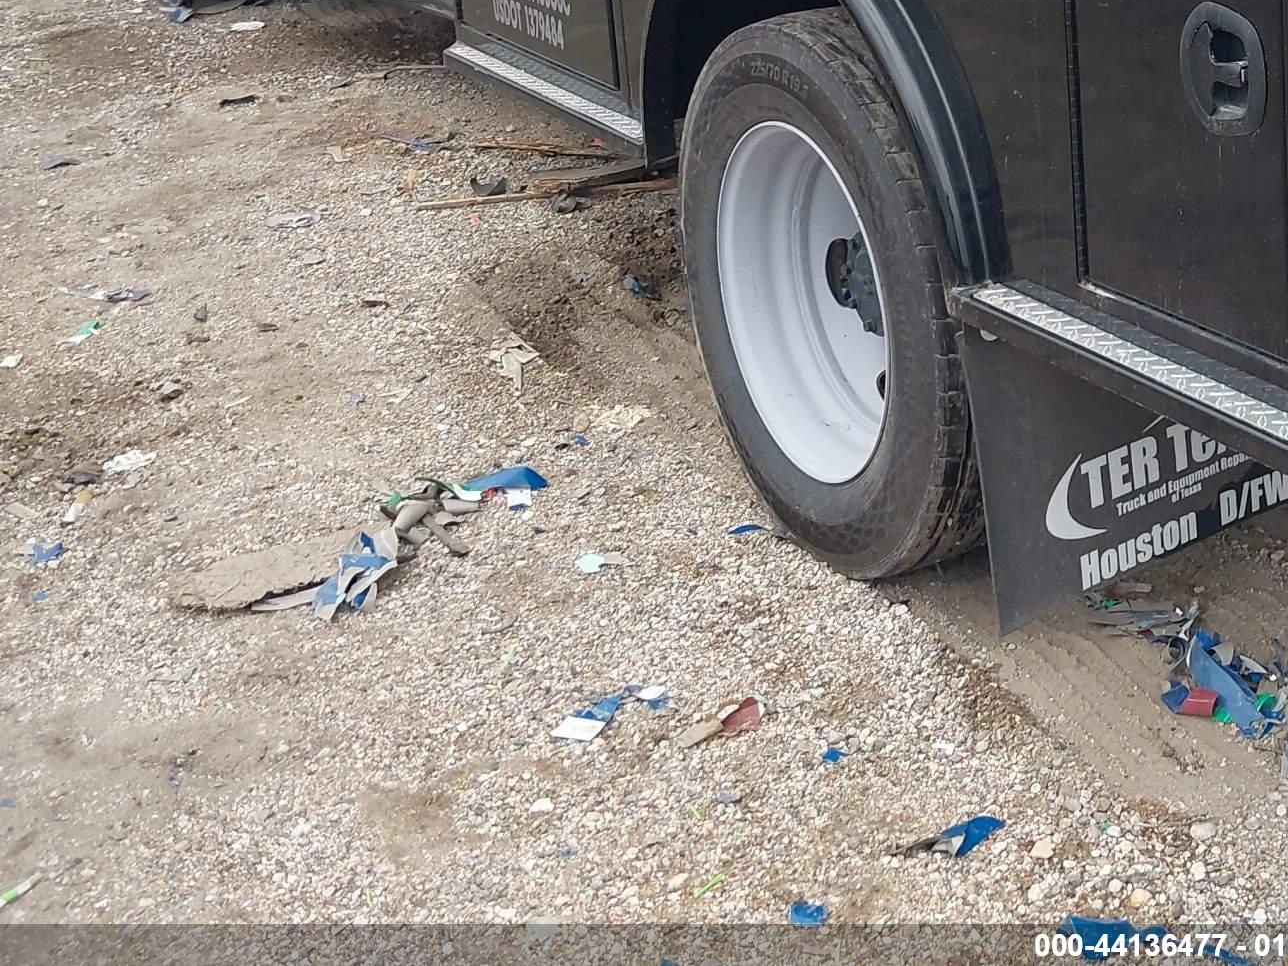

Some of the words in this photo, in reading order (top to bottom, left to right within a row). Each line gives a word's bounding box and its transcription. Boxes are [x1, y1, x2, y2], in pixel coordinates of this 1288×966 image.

[1080, 436, 1160, 509] TER
[1116, 492, 1147, 517] Truck
[1147, 482, 1167, 504] and
[1168, 461, 1220, 494] Equipment
[1171, 487, 1180, 503] of
[1180, 482, 1202, 499] Texas
[1080, 511, 1198, 591] Houston
